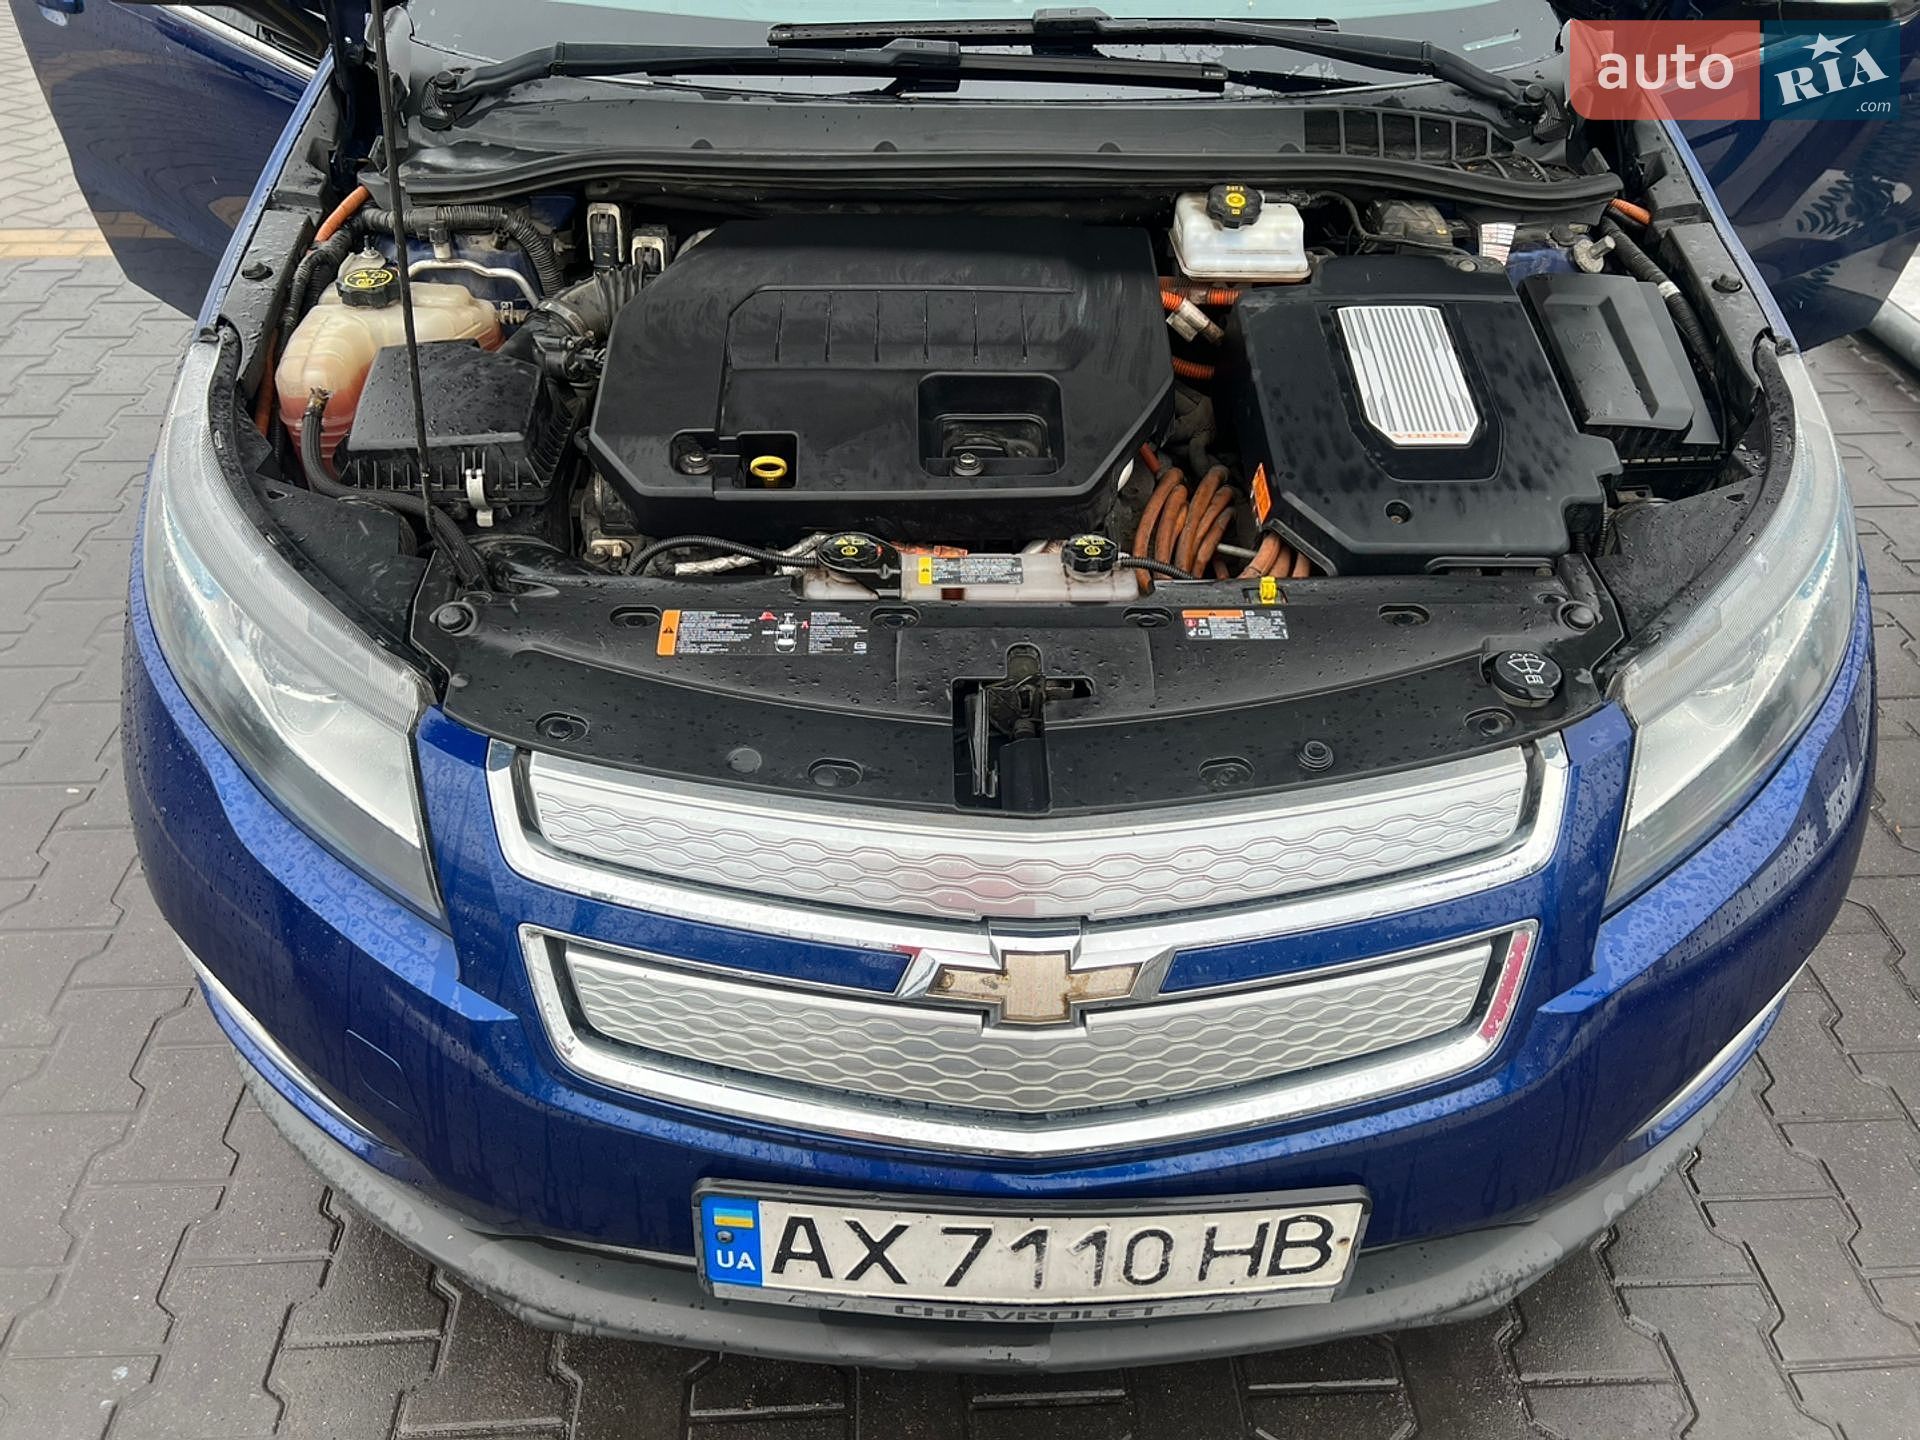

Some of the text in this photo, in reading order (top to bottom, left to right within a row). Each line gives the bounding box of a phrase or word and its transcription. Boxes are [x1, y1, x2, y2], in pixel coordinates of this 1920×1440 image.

[716, 1249, 756, 1271] UA
[770, 1214, 1334, 1289] AX 7110 HB
[894, 1303, 1163, 1322] CHEVROLET
